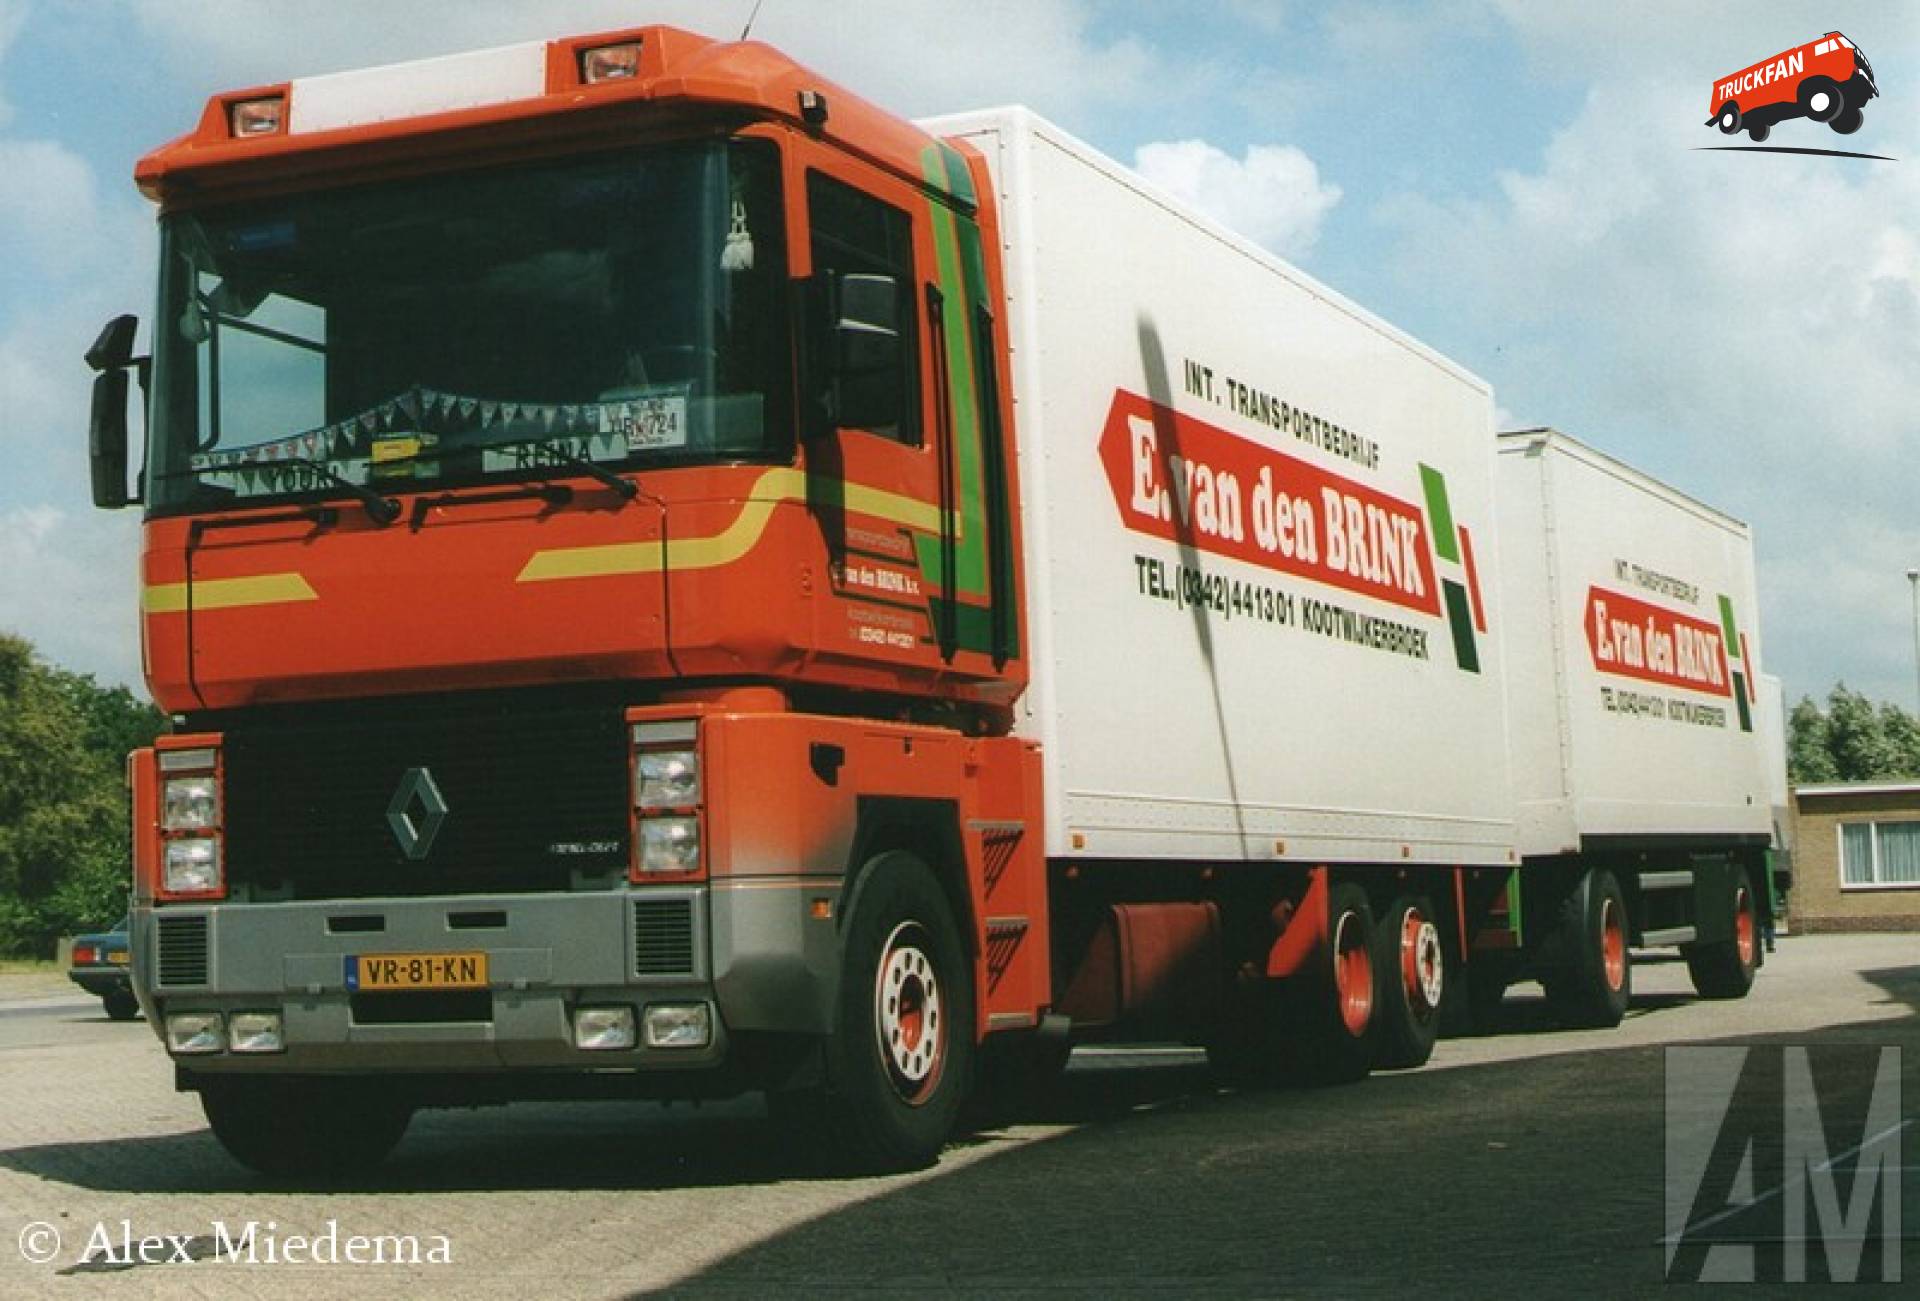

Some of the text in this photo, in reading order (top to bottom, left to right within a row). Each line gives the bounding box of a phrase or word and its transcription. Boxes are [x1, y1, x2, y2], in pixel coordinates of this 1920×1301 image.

[1184, 357, 1380, 471] INT. TRANSPORTBEDRIJF
[1168, 454, 1244, 543] van
[1252, 464, 1318, 565] den
[1321, 486, 1425, 598] BRINK
[366, 957, 476, 985] VR-81-KN
